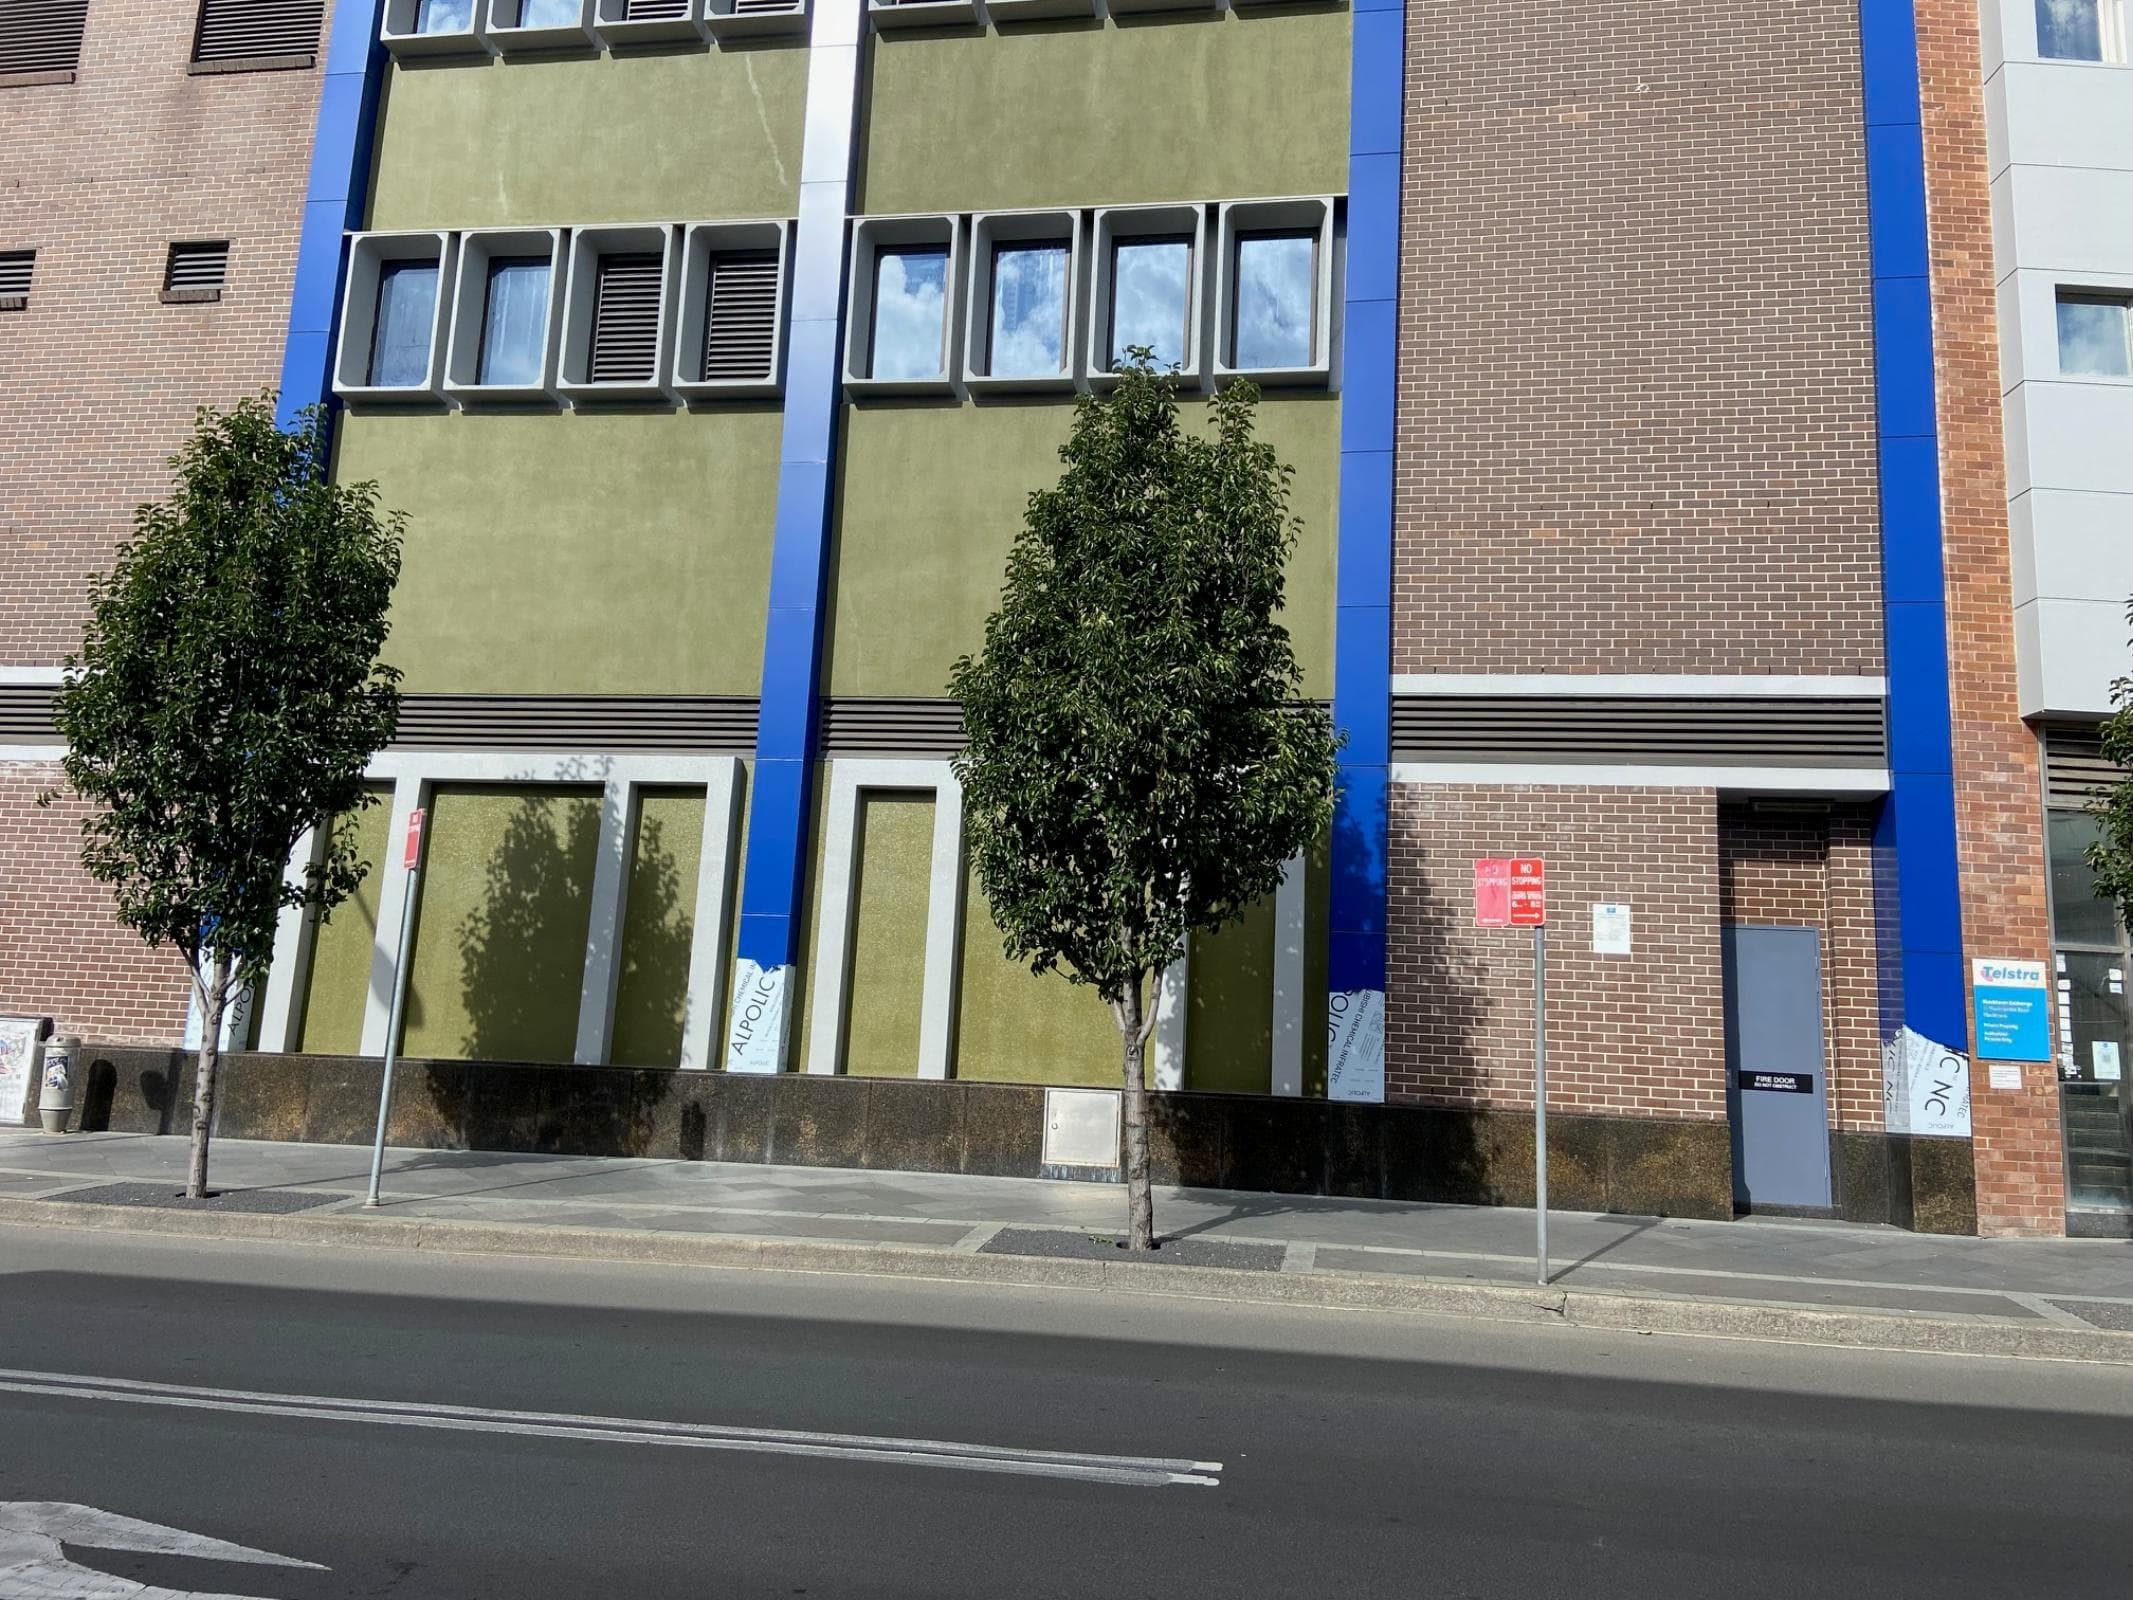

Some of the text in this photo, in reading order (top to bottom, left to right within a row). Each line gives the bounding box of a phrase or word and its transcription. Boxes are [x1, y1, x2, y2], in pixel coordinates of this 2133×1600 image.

[1520, 863, 1532, 874] NO
[1511, 876, 1542, 886] STOPPING
[1982, 966, 2040, 981] Telstra
[731, 976, 775, 1056] ALPOLIC
[1755, 1075, 1796, 1085] FIRE DOOR
[1925, 1079, 1953, 1117] NC
